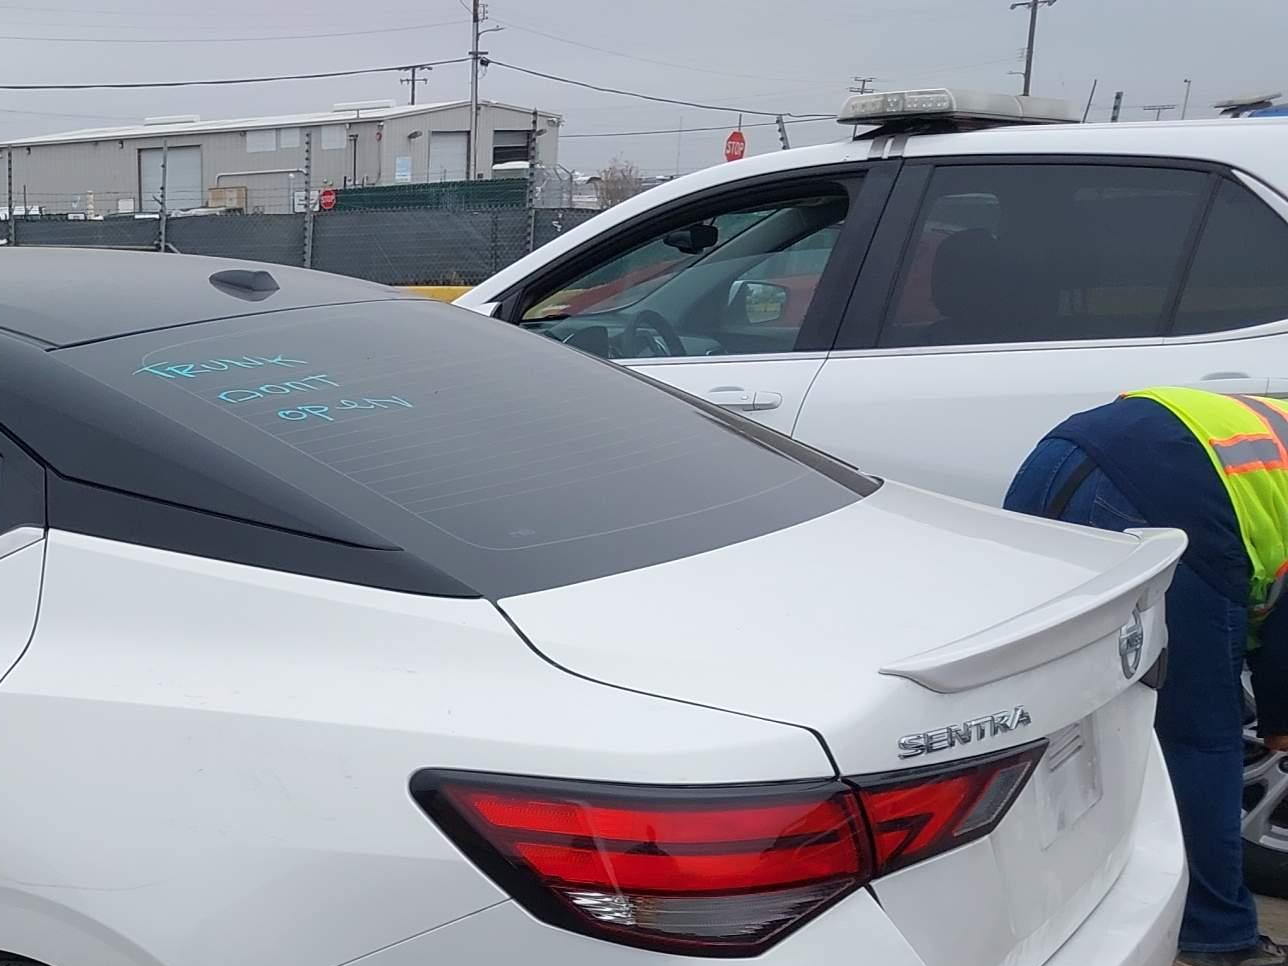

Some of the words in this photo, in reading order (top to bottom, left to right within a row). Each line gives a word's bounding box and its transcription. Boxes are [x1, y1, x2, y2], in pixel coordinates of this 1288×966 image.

[726, 141, 744, 156] STOP
[132, 354, 307, 378] TRUNK
[897, 704, 1032, 760] SENTRA
